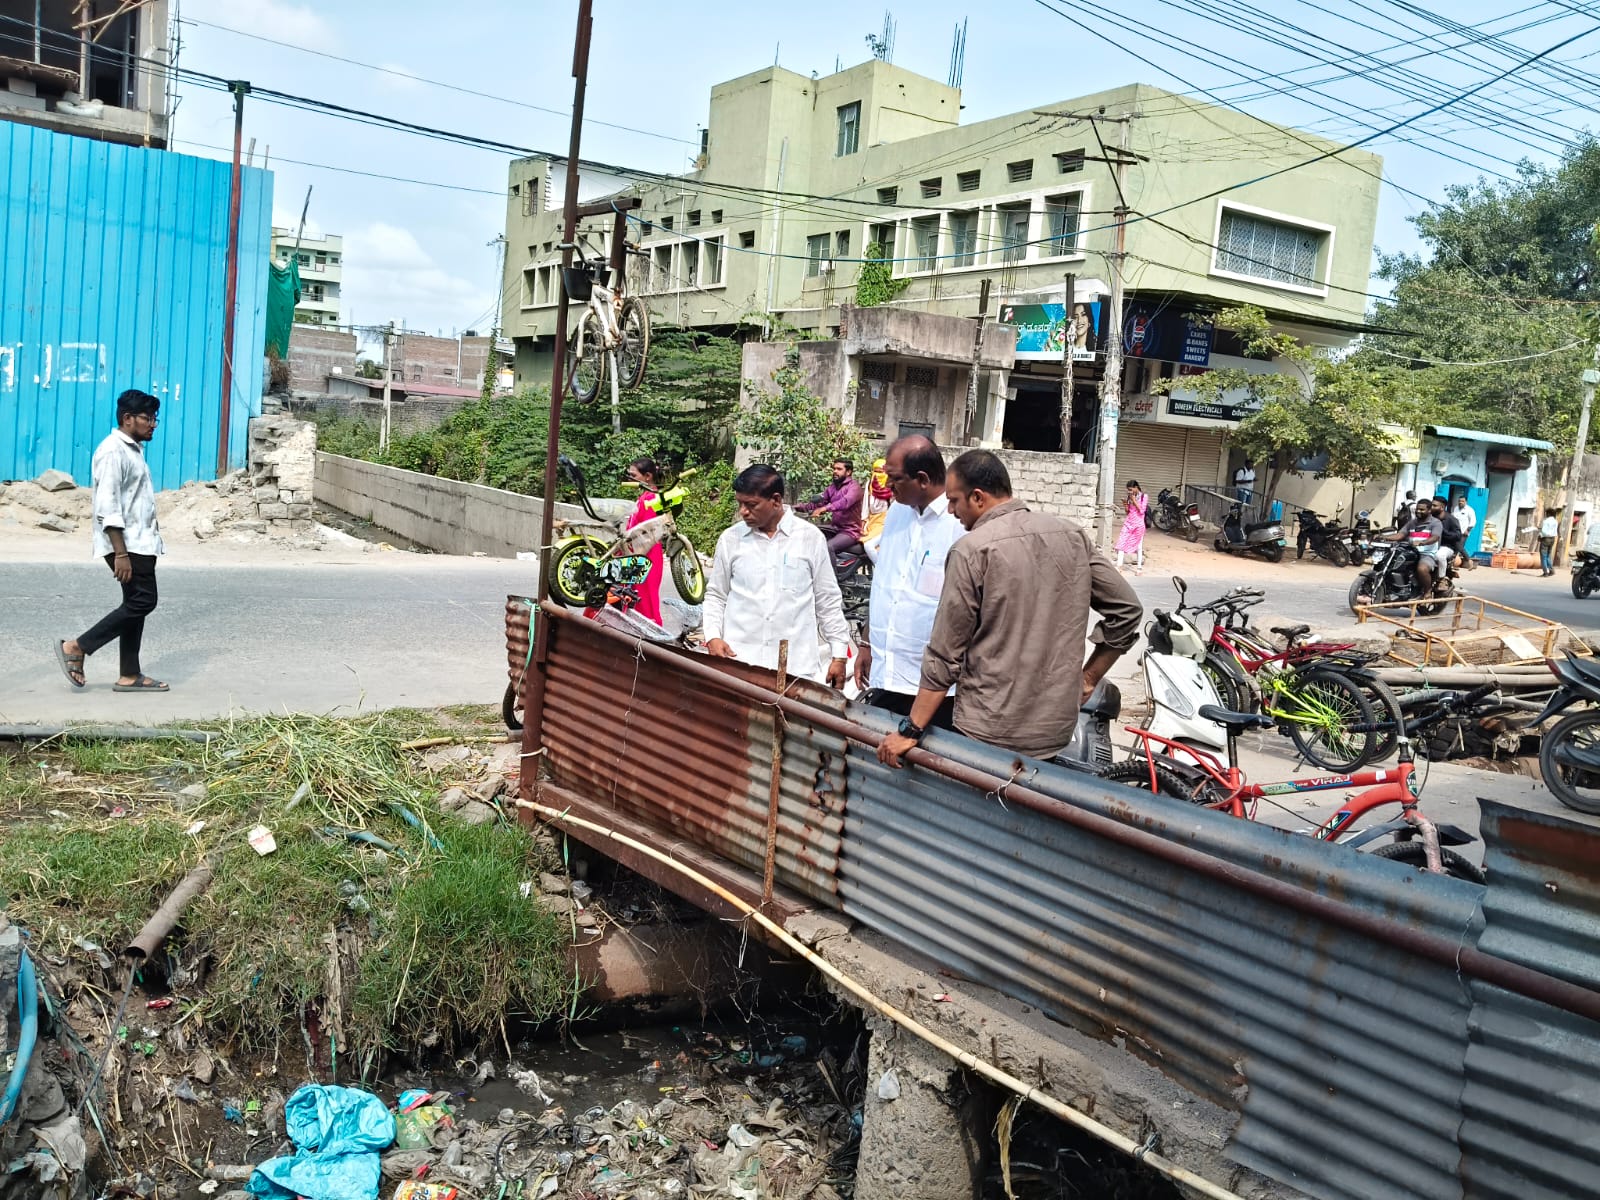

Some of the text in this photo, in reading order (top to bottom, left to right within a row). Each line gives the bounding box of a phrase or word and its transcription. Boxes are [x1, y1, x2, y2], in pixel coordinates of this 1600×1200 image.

[1186, 346, 1206, 355] SWEETS
[1184, 353, 1205, 362] BAKERY
[1192, 403, 1223, 414] ELECTRICALS
[1311, 774, 1351, 786] VIRAJ
